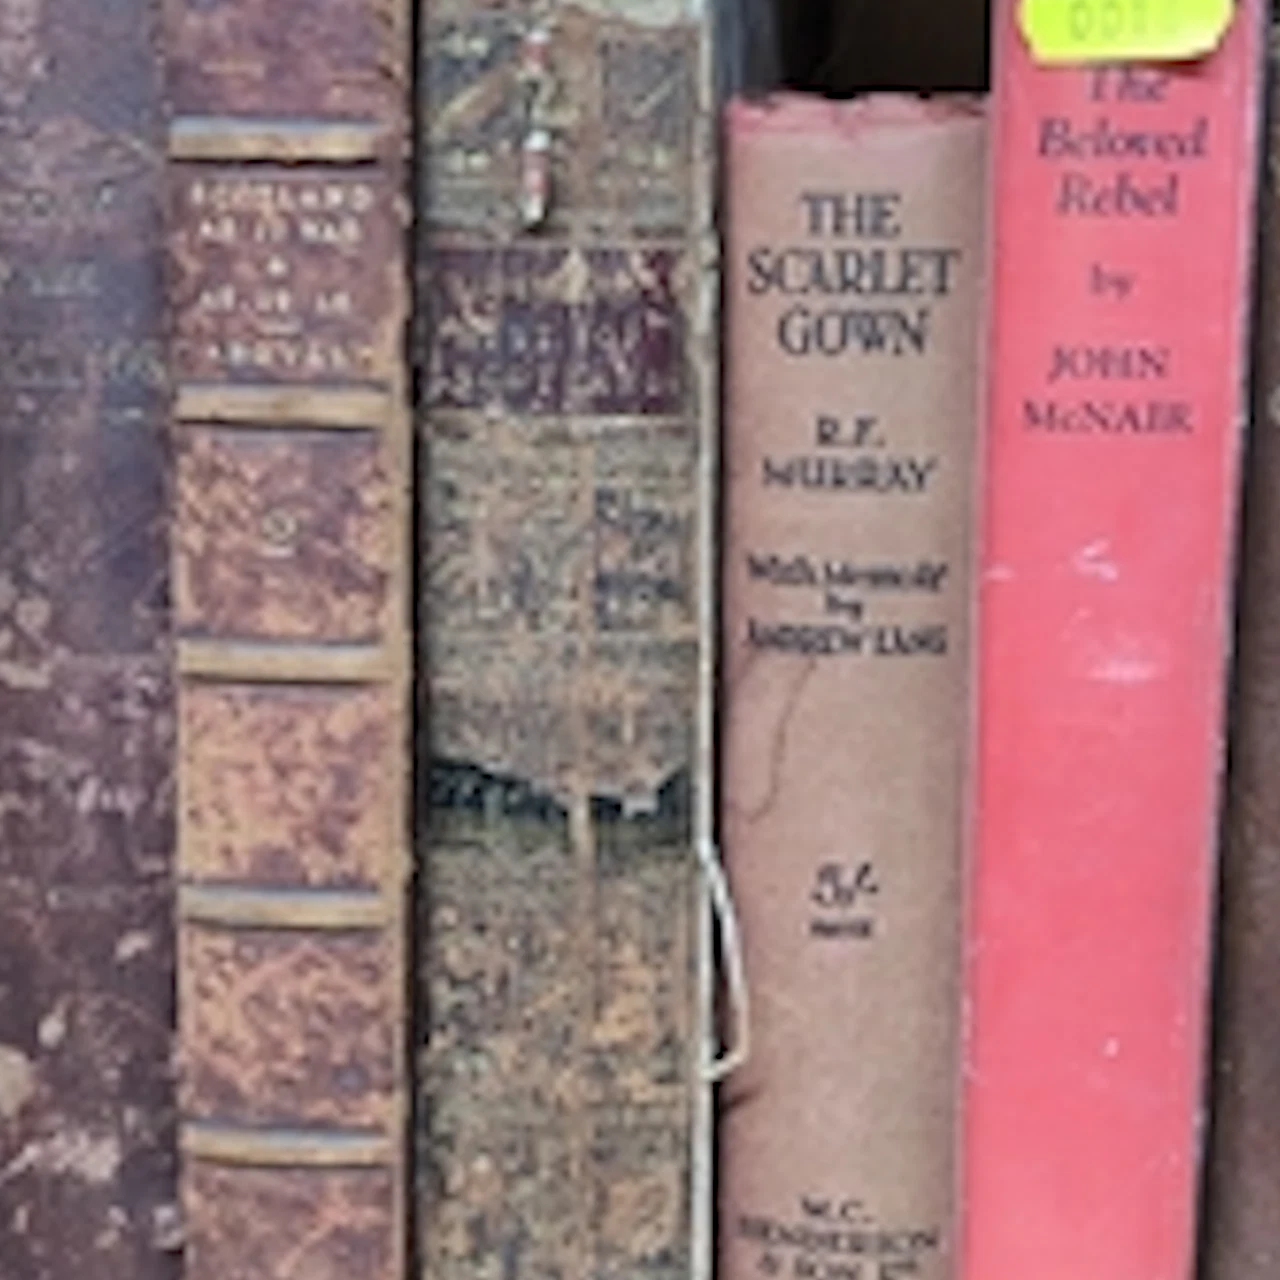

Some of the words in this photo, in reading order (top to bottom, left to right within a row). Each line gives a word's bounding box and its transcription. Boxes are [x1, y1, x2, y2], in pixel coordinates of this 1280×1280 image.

[1037, 118, 1209, 163] Beloved
[801, 192, 901, 238] THE
[1057, 174, 1179, 218] Rebel
[745, 248, 962, 297] SCARLET
[1087, 262, 1134, 301] by
[777, 305, 931, 357] GOWN
[1048, 346, 1170, 381] JOHN
[762, 456, 937, 493] MURRAY
